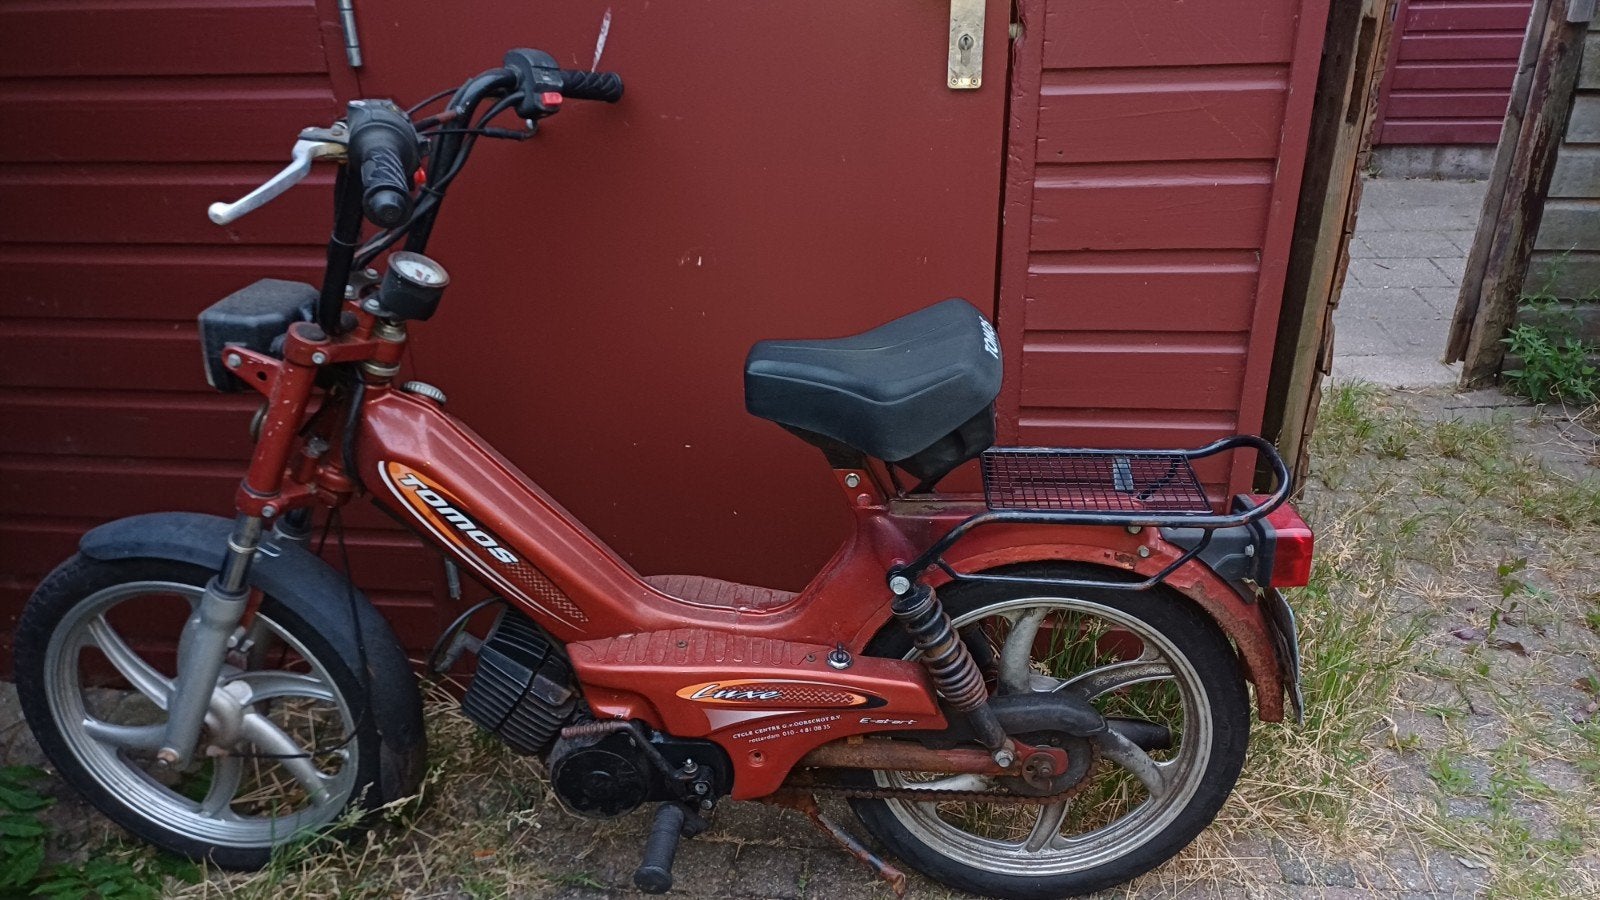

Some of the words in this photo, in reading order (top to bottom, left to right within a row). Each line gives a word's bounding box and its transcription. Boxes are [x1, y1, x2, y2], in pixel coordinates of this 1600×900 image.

[399, 473, 519, 563] TOMOS
[690, 683, 781, 700] Luxe
[732, 731, 753, 739] CYCLE
[754, 725, 781, 734] CENTRE
